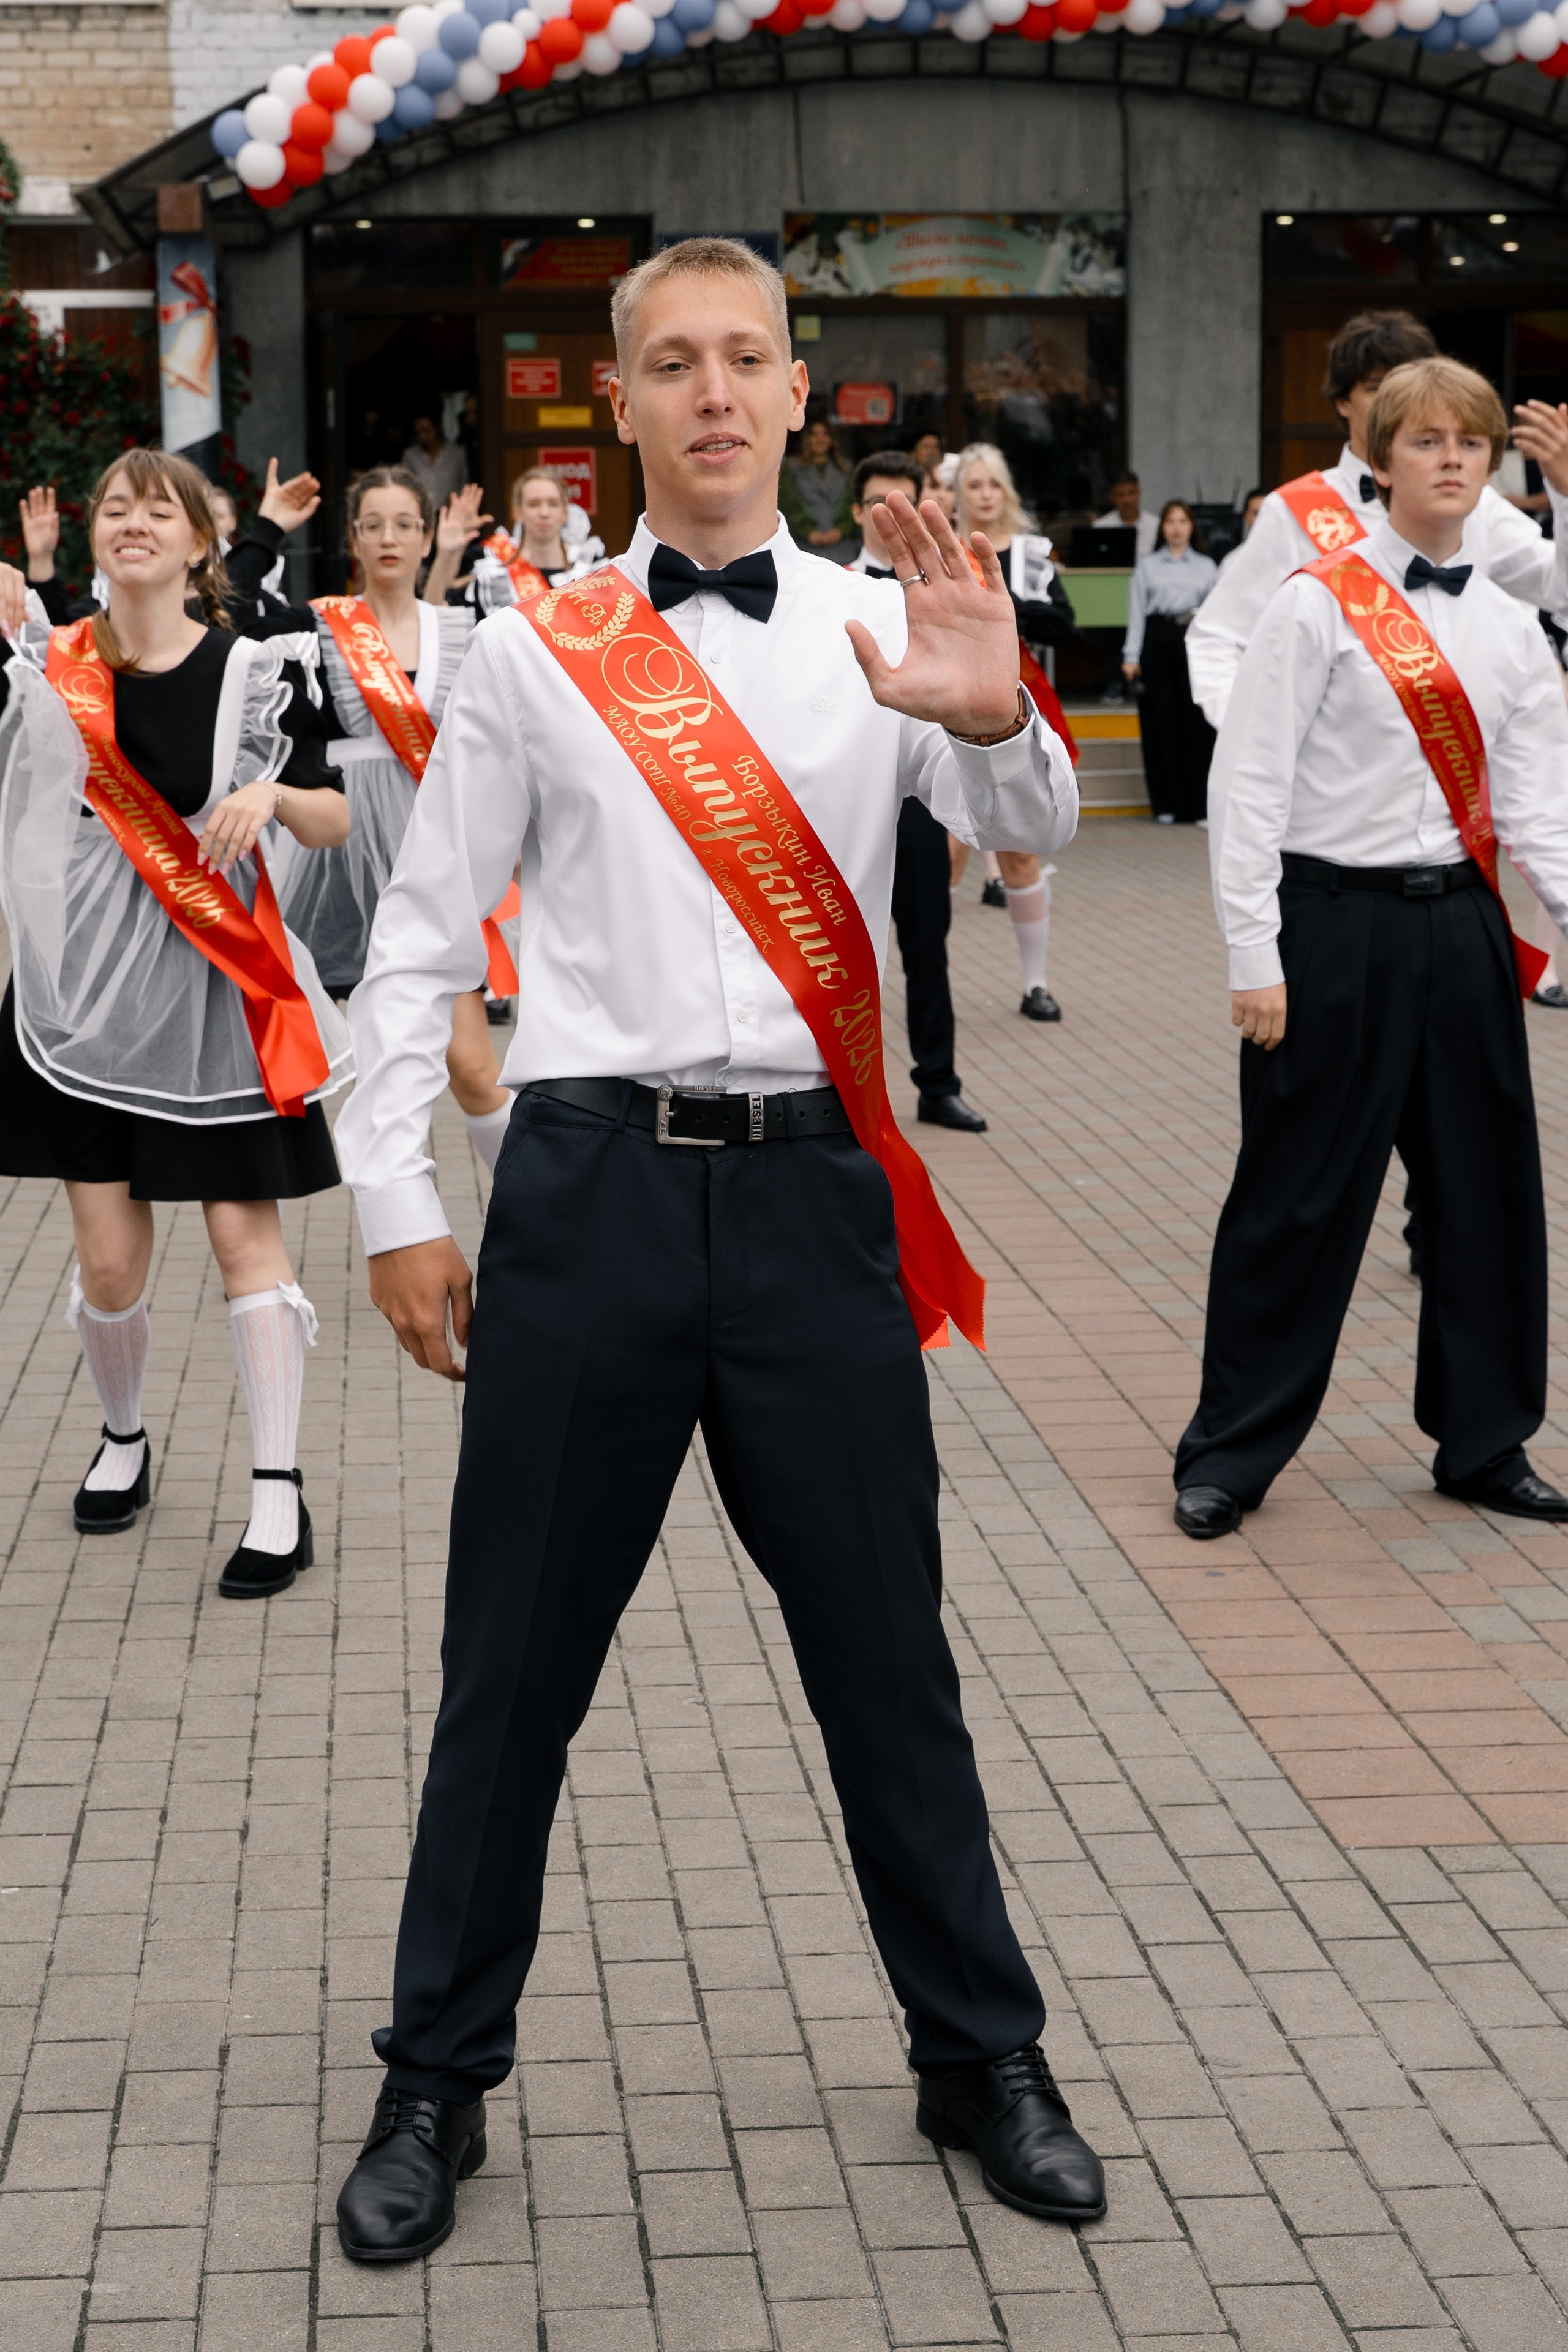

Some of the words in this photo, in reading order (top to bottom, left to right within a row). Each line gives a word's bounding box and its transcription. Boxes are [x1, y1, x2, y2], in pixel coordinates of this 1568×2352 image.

[1372, 608, 1483, 825] Выпускник
[147, 798, 183, 836] Арина
[164, 868, 235, 929] 2026
[601, 633, 849, 990] Выпускник
[829, 989, 880, 1086] 2026
[602, 704, 647, 748] МАОУ
[636, 750, 671, 790] СОШ
[660, 787, 692, 821] №40
[701, 848, 712, 858] г.
[708, 859, 776, 954] Новороссийск
[731, 755, 812, 867] Борзыкин
[803, 865, 848, 927] Иван
[752, 1094, 762, 1140] DIESEL
